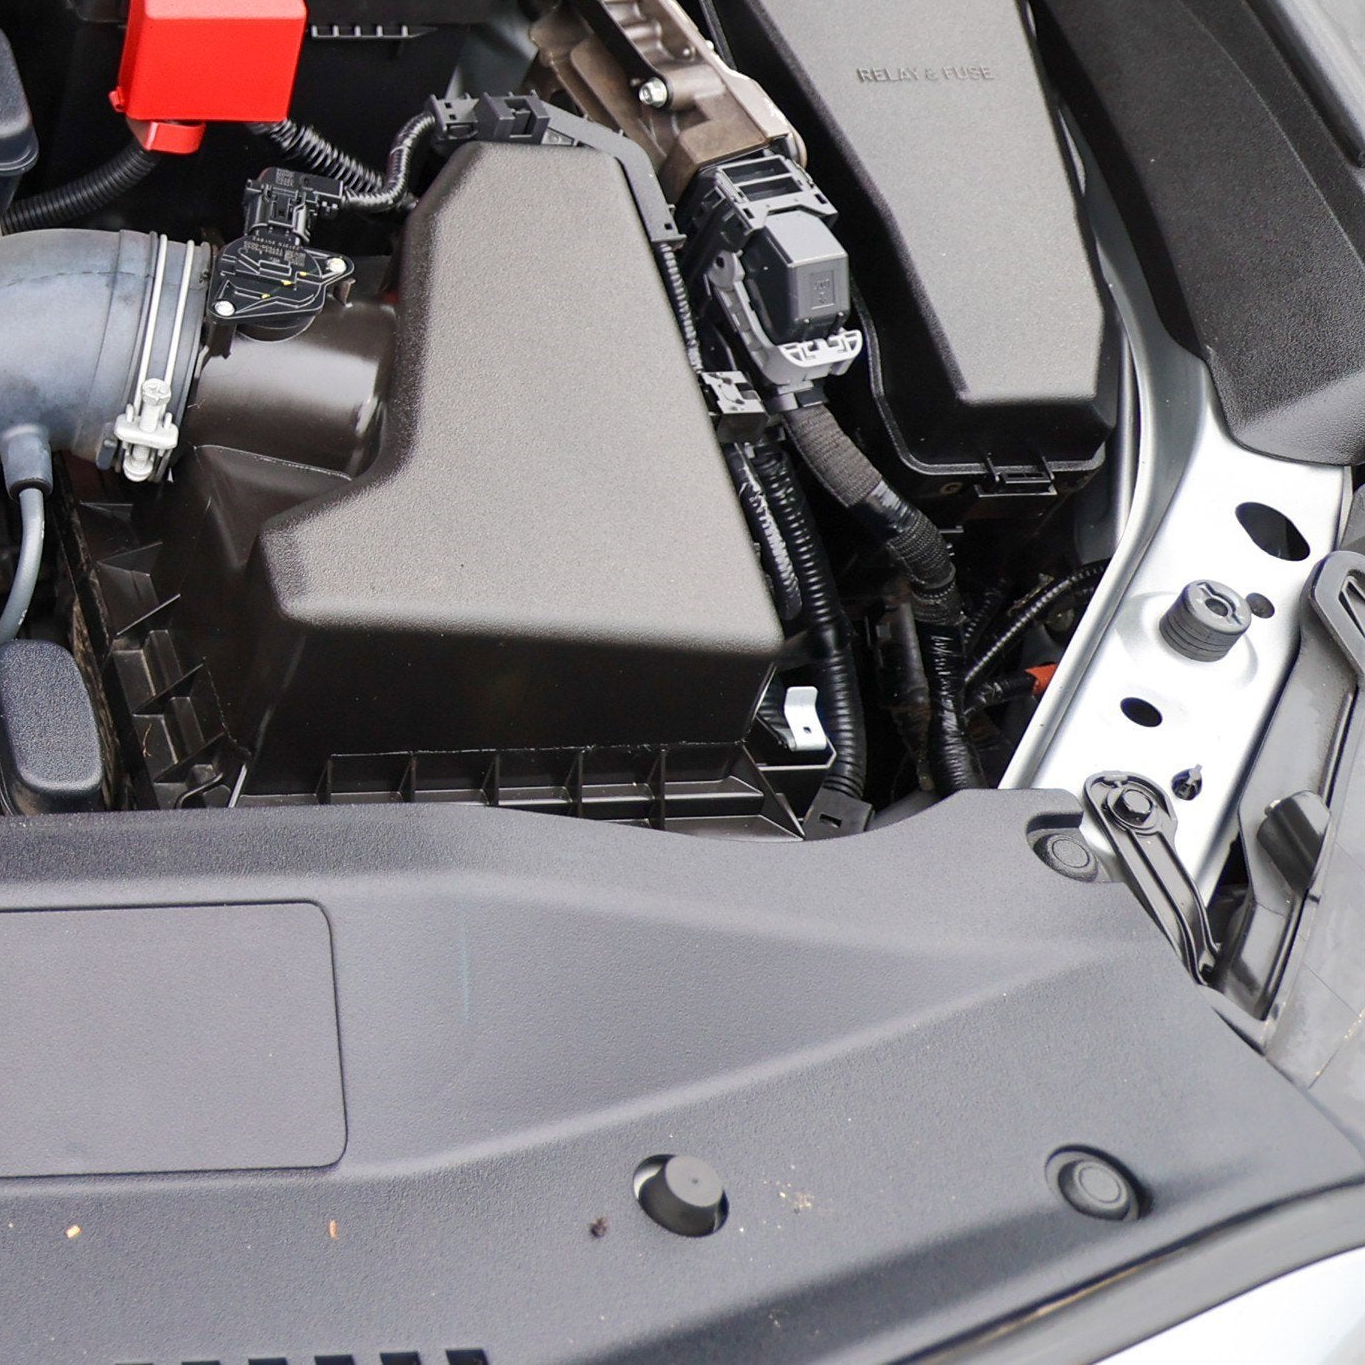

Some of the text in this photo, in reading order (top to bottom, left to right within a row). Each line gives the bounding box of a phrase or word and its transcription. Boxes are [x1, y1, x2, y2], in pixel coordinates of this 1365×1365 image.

[857, 66, 995, 83] RELAY & FUSE
